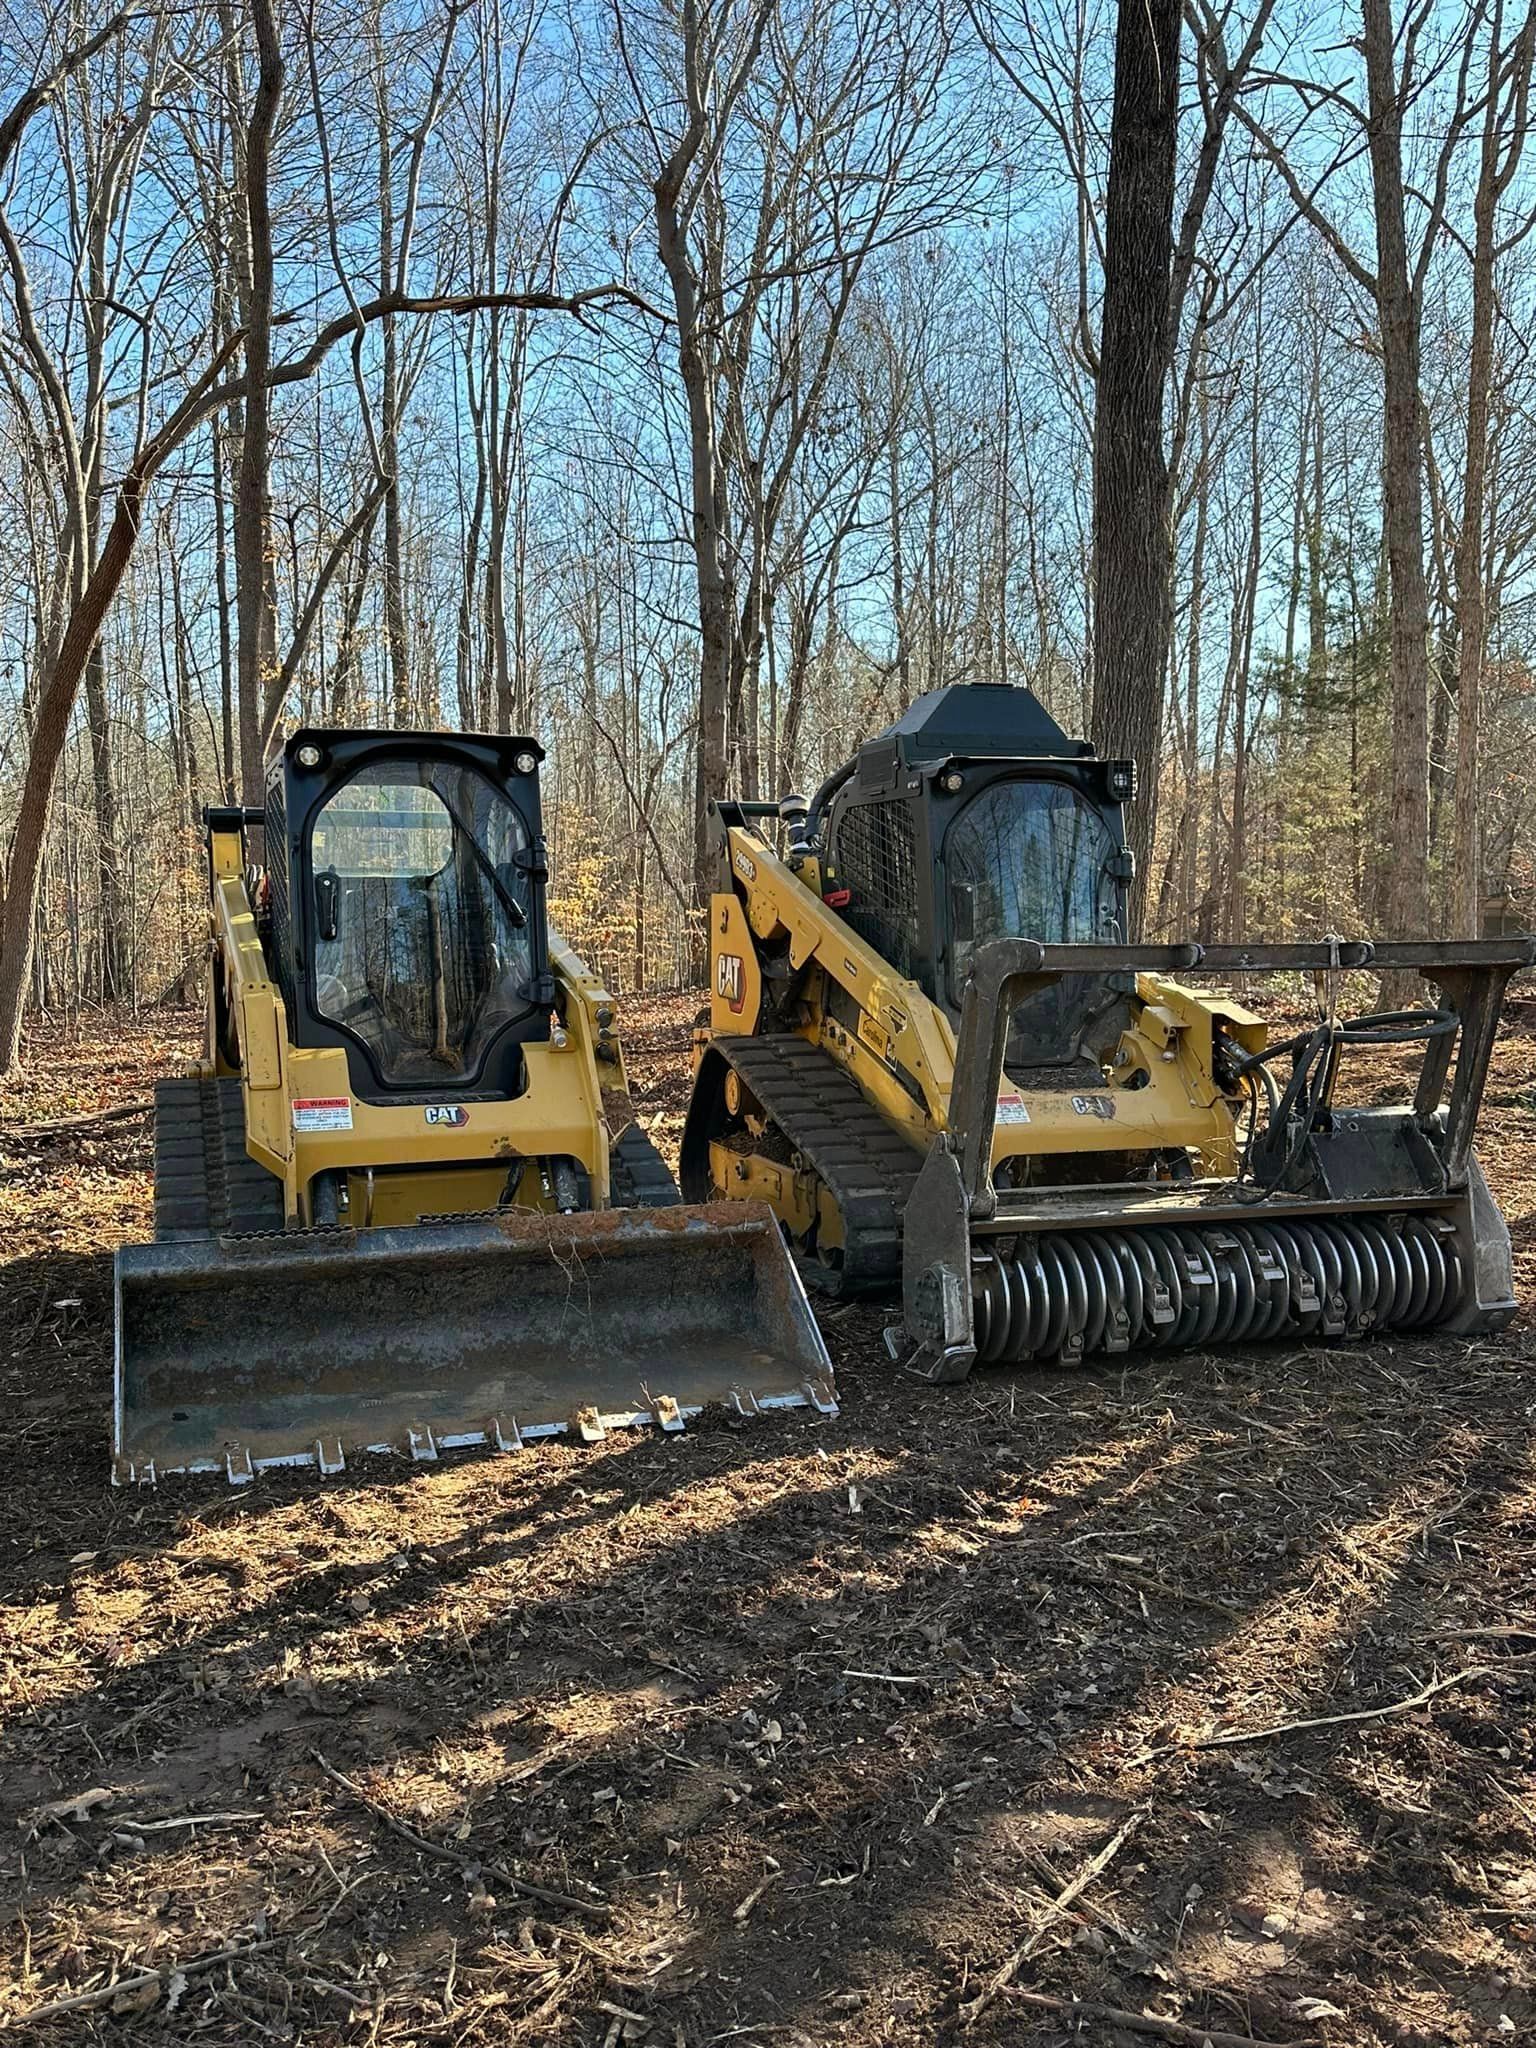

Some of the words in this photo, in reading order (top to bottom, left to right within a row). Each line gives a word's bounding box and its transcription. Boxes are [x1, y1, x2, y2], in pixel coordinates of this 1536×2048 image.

[718, 954, 741, 1001] CAT
[310, 1099, 348, 1107] WARNING
[425, 1106, 459, 1124] CAT
